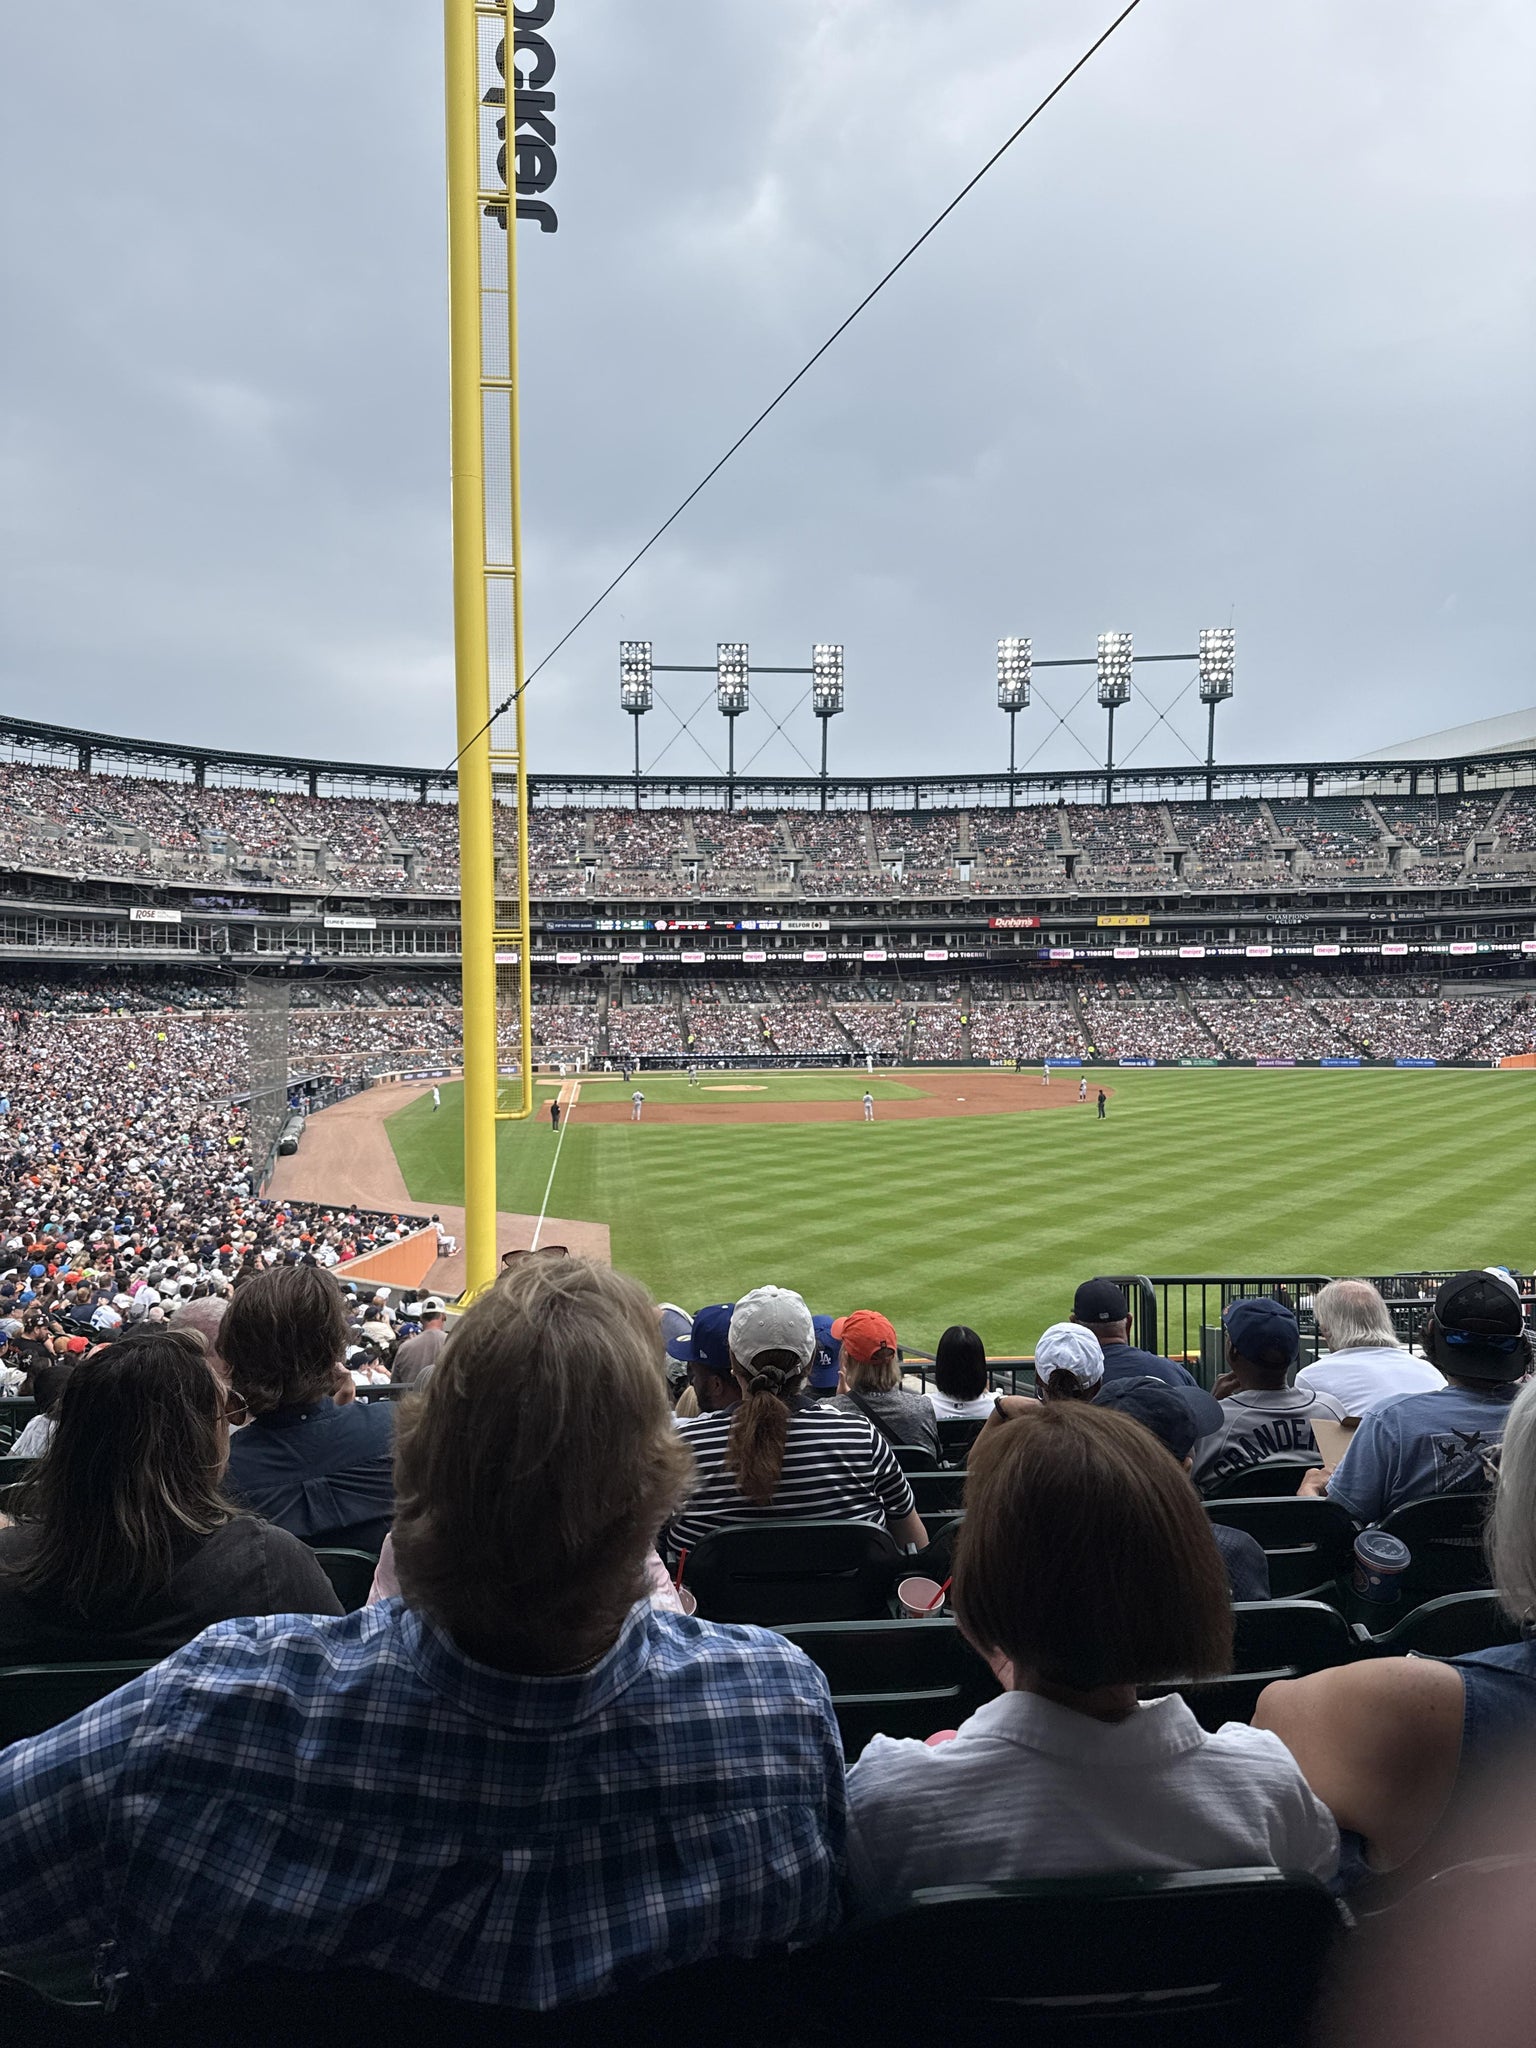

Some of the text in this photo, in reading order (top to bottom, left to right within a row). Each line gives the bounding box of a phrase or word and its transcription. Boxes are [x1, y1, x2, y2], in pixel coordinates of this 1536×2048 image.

[136, 910, 155, 919] ROSE
[995, 917, 1033, 926] Dunham's
[819, 1350, 832, 1366] LA
